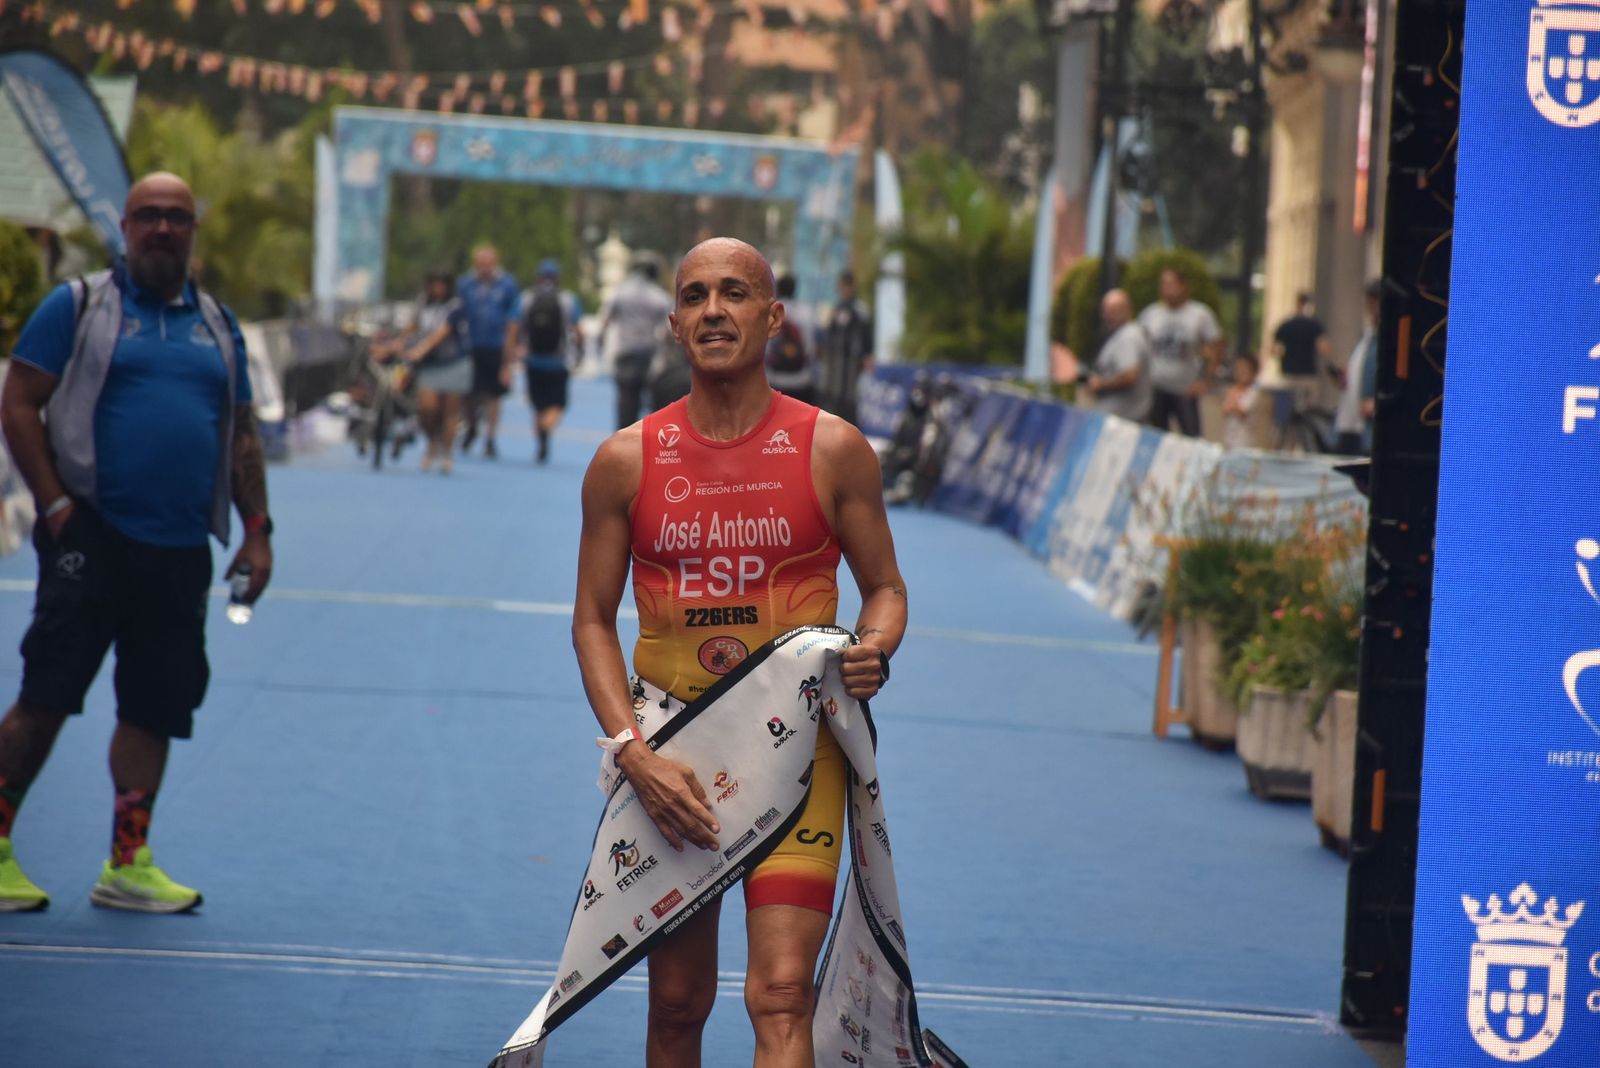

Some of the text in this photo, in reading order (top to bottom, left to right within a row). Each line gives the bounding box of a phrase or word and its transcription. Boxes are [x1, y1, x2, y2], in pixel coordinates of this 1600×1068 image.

[747, 482, 782, 491] MURCIA
[654, 507, 791, 552] José Antonio
[678, 555, 765, 598] ESP
[685, 606, 758, 627] 226ERS
[616, 855, 658, 891] FETRICE
[692, 903, 701, 912] DE
[722, 878, 731, 886] DE
[729, 865, 746, 881] CEUTA
